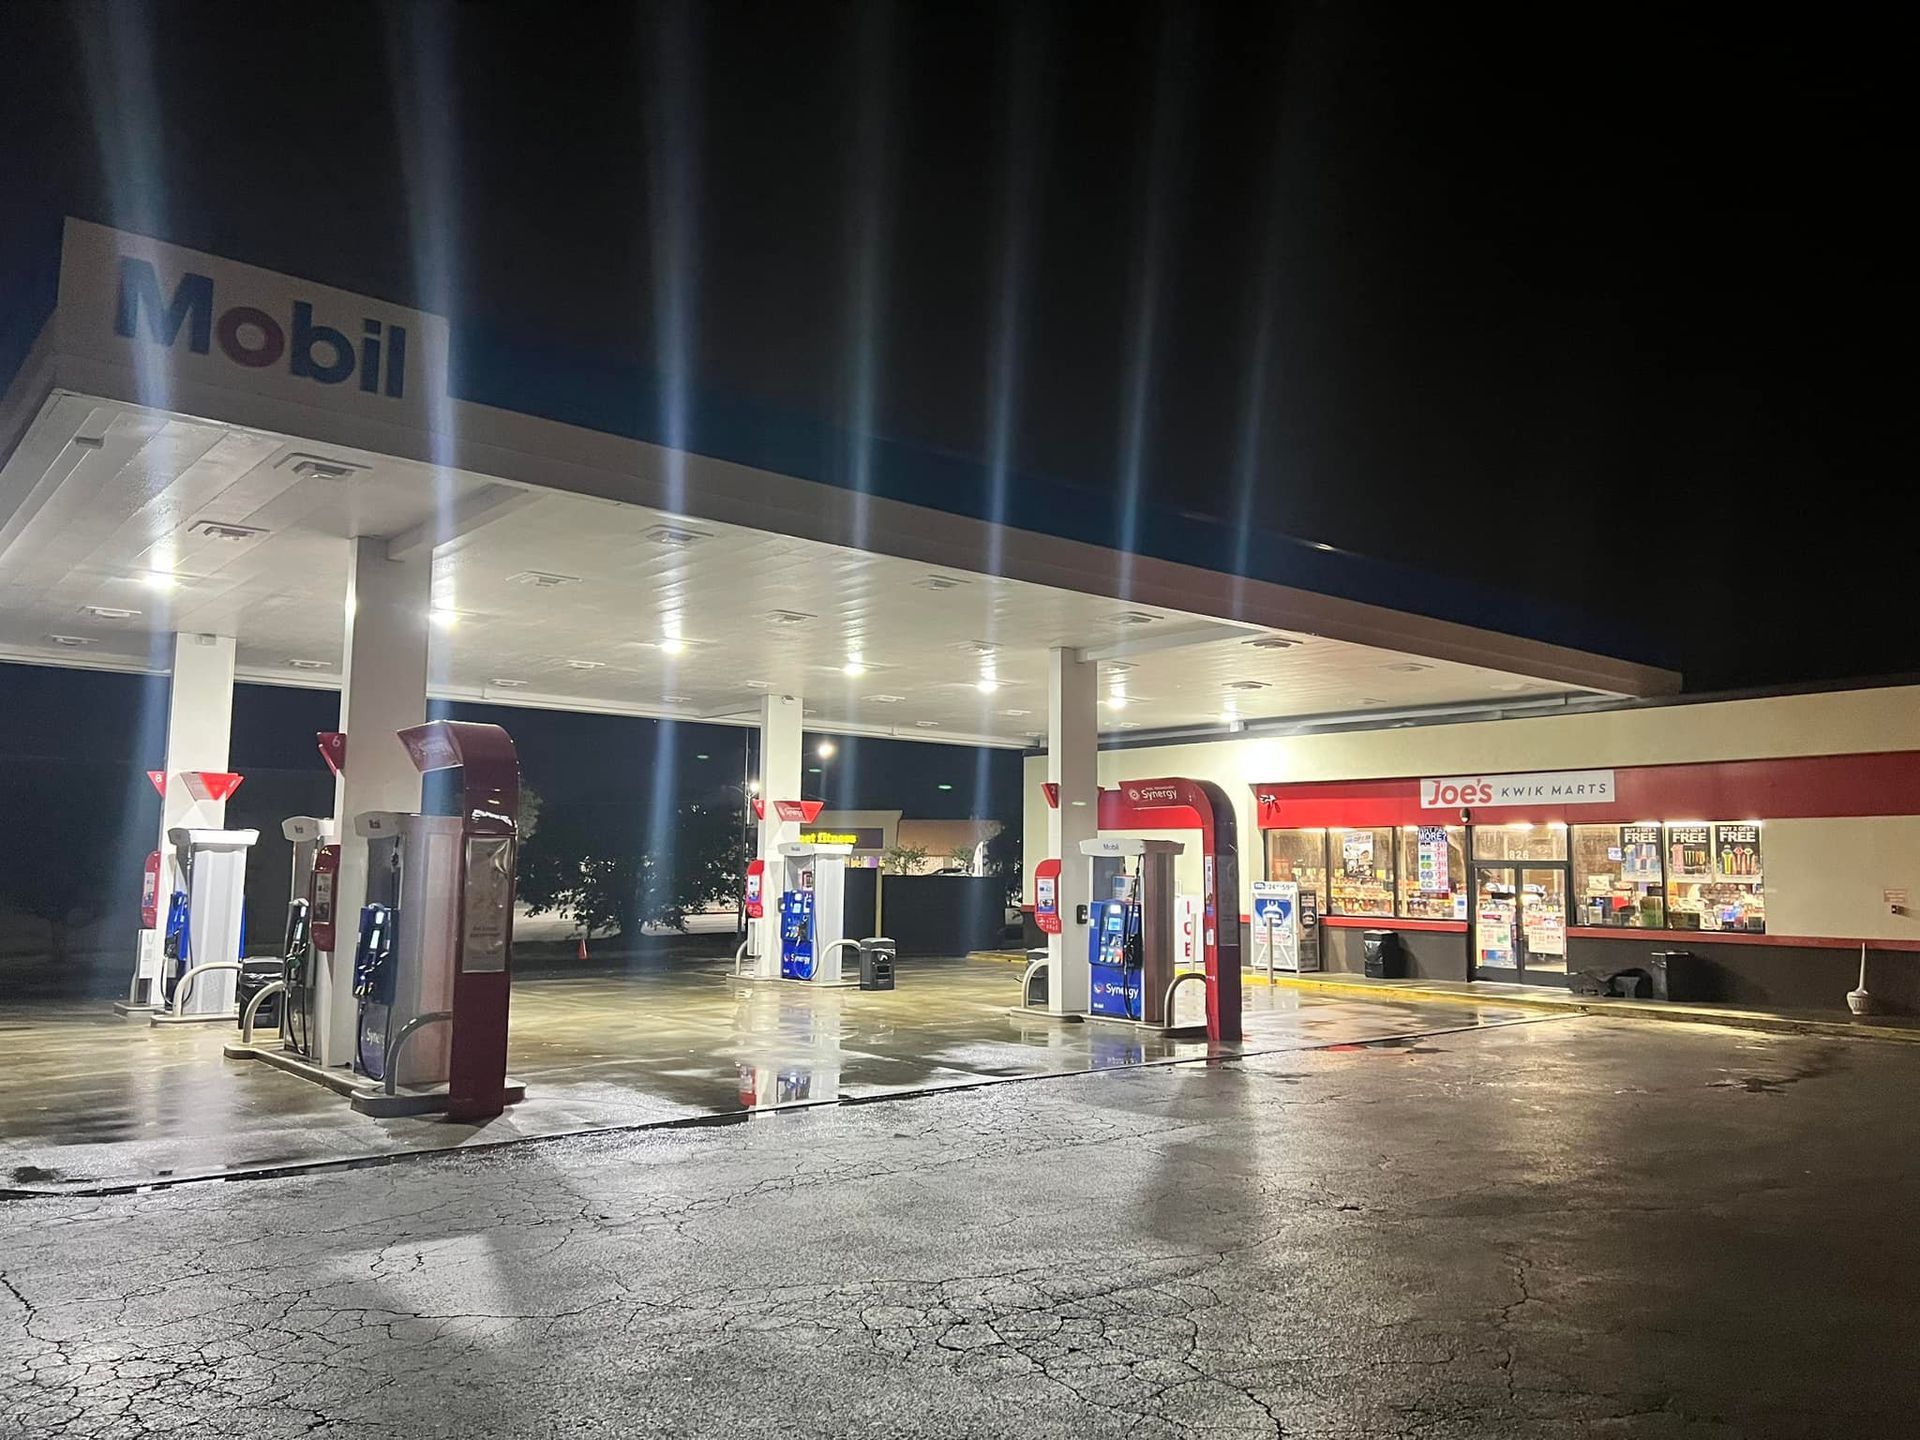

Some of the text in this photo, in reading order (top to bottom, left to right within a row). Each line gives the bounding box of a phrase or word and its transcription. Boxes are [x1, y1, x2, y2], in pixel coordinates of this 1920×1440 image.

[114, 254, 407, 399] Mobil
[332, 735, 341, 748] 6
[155, 774, 162, 783] 8
[1141, 789, 1177, 800] Synergy
[1428, 778, 1607, 806] Joe's KWIK MARTS
[1624, 832, 1657, 843] FREE
[1672, 832, 1707, 843] FREE
[1719, 832, 1756, 842] FREE
[1508, 850, 1529, 860] 826
[1183, 900, 1192, 957] ICE
